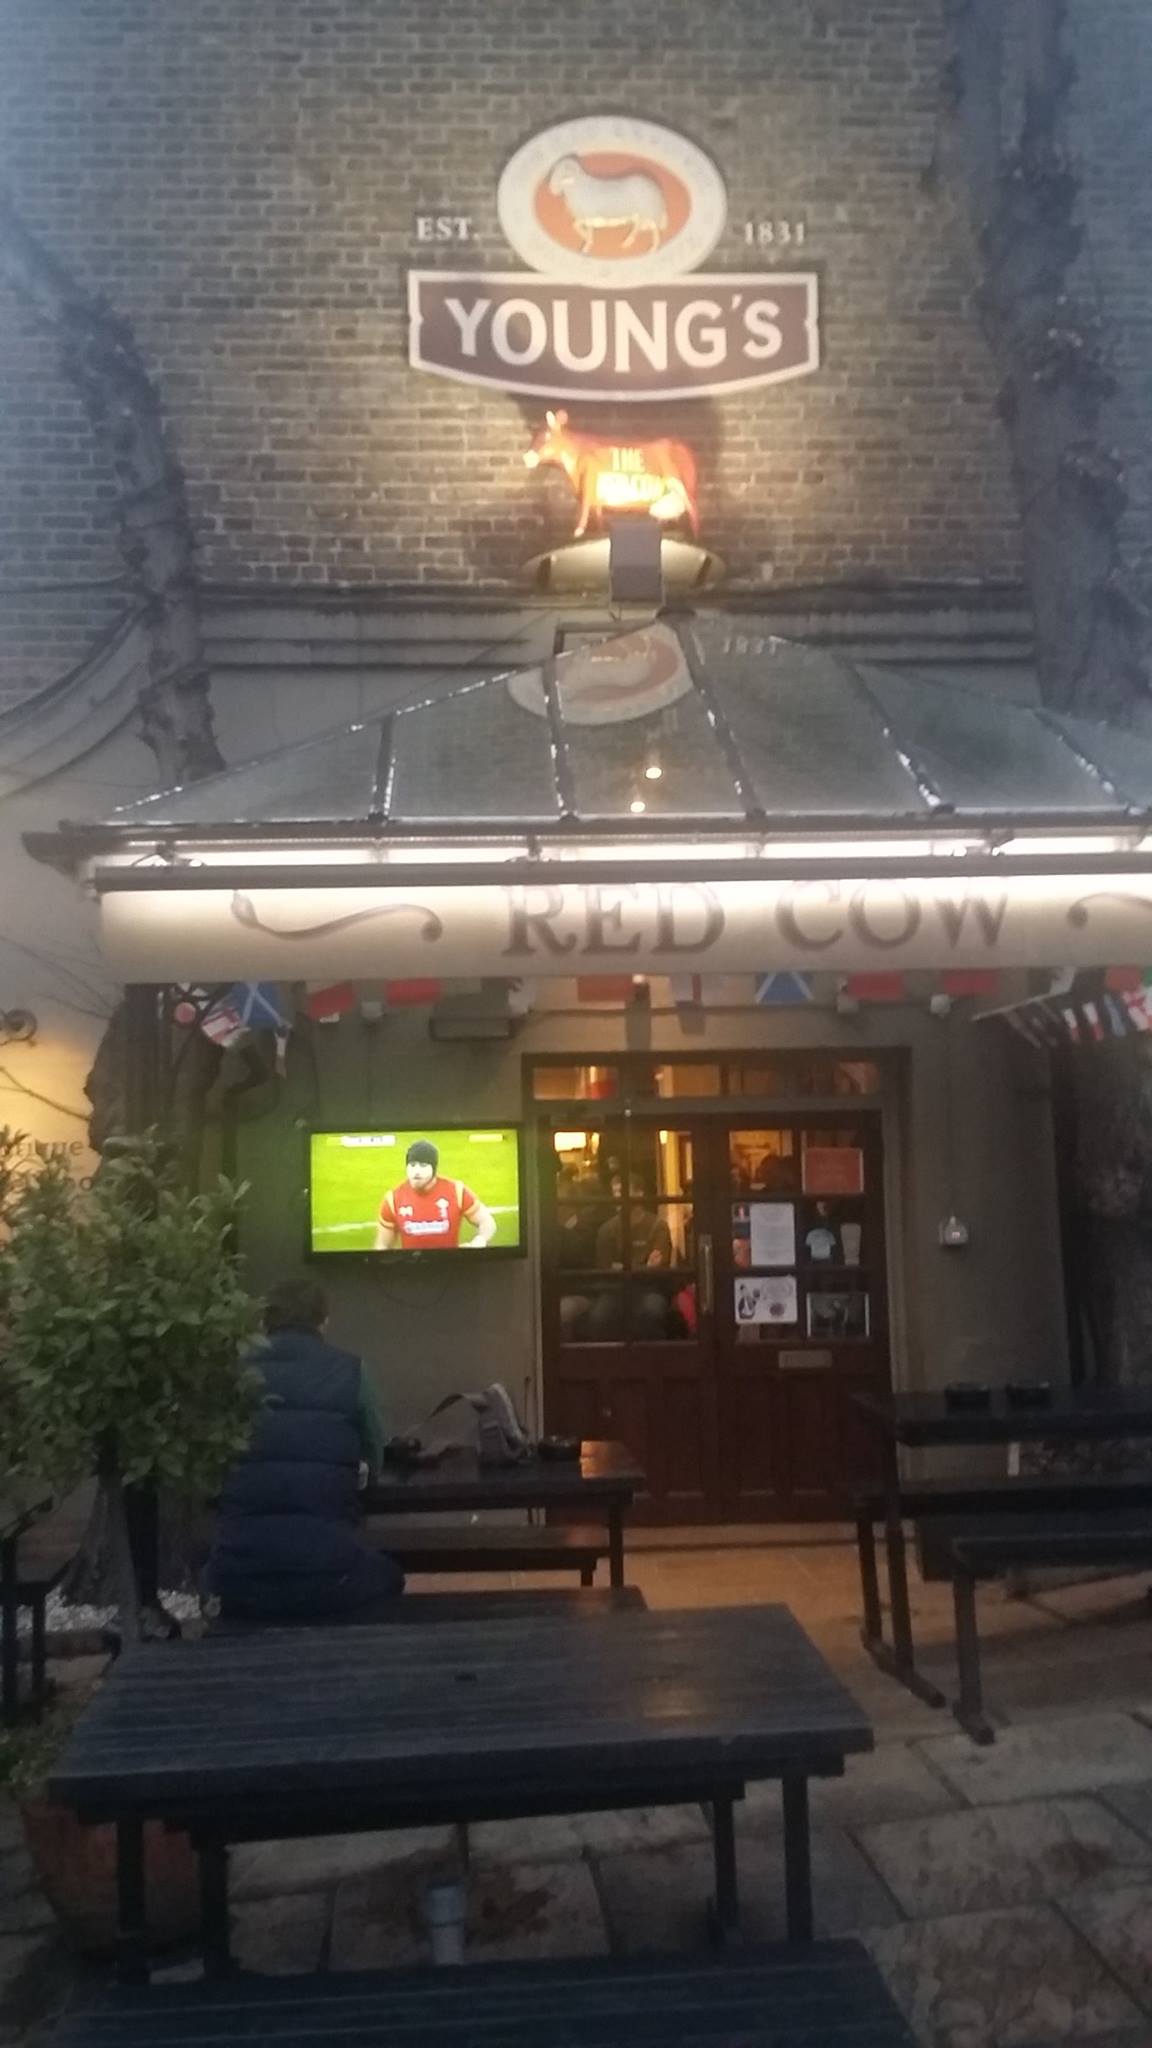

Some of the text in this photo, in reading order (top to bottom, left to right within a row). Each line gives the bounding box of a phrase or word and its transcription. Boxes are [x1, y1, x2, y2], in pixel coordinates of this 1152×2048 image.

[416, 217, 481, 242] EST.
[743, 221, 806, 245] 1831
[444, 293, 784, 374] YOUNG'S
[502, 876, 1009, 956] RED COW
